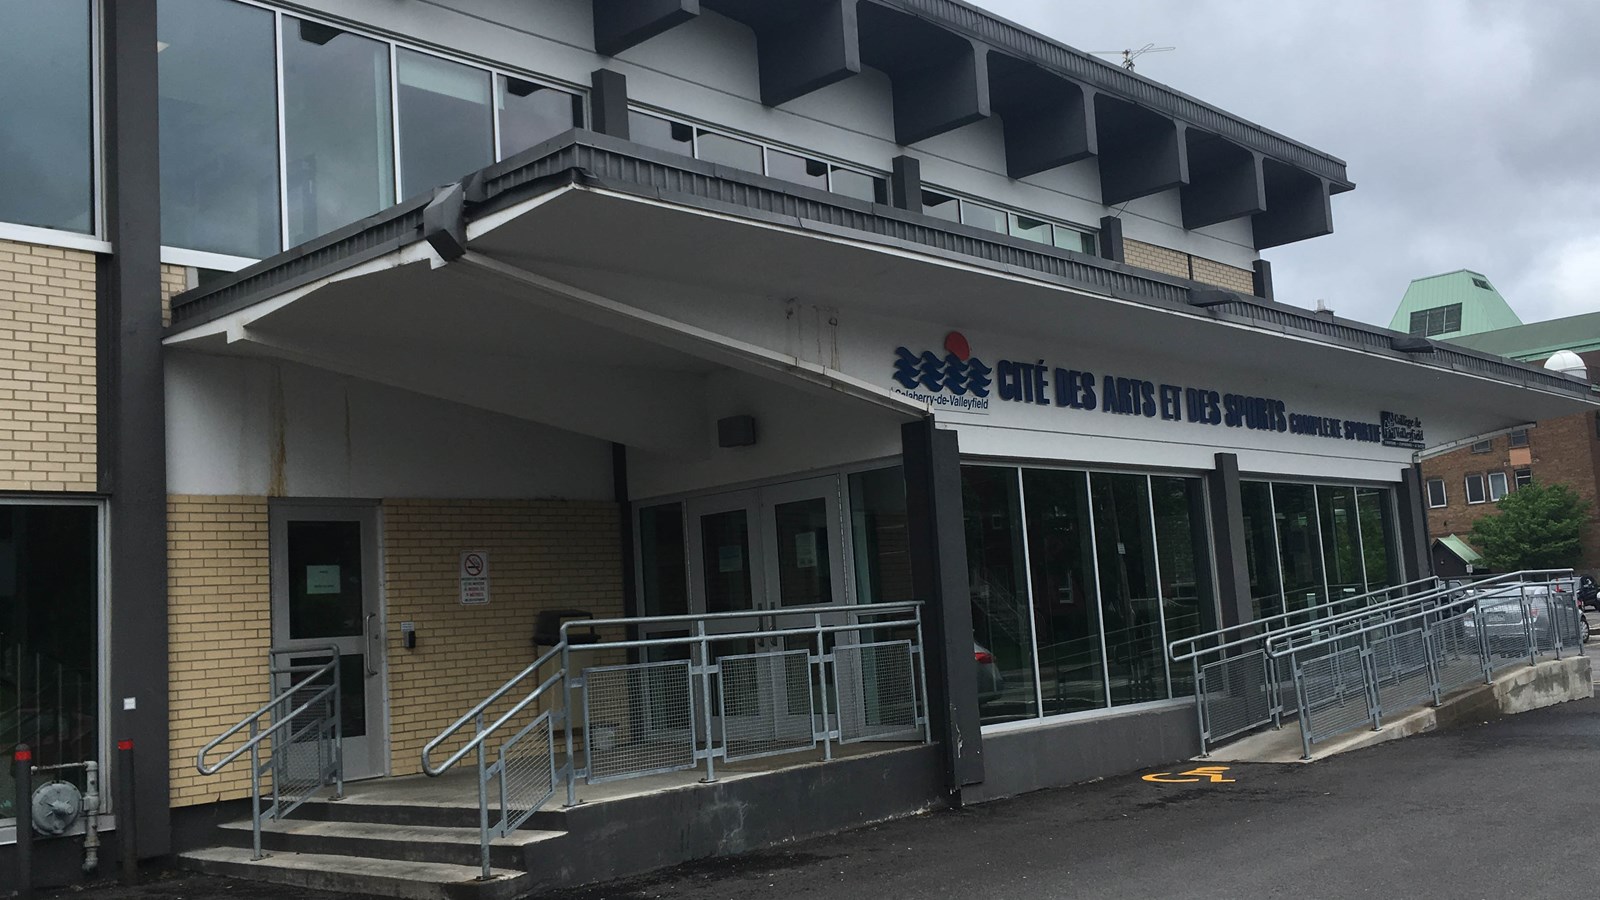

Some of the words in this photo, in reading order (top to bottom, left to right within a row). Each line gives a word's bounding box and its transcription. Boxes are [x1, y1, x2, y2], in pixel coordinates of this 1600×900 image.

[997, 359, 1050, 405] CITÉ
[1055, 367, 1097, 410] DES
[1102, 375, 1157, 418] ARTS
[1159, 384, 1182, 421] ET
[1185, 387, 1222, 426] DES
[1223, 393, 1288, 433] SPORTS
[1289, 412, 1343, 439] COMPLEXE
[1343, 420, 1381, 443] SPORTIF
